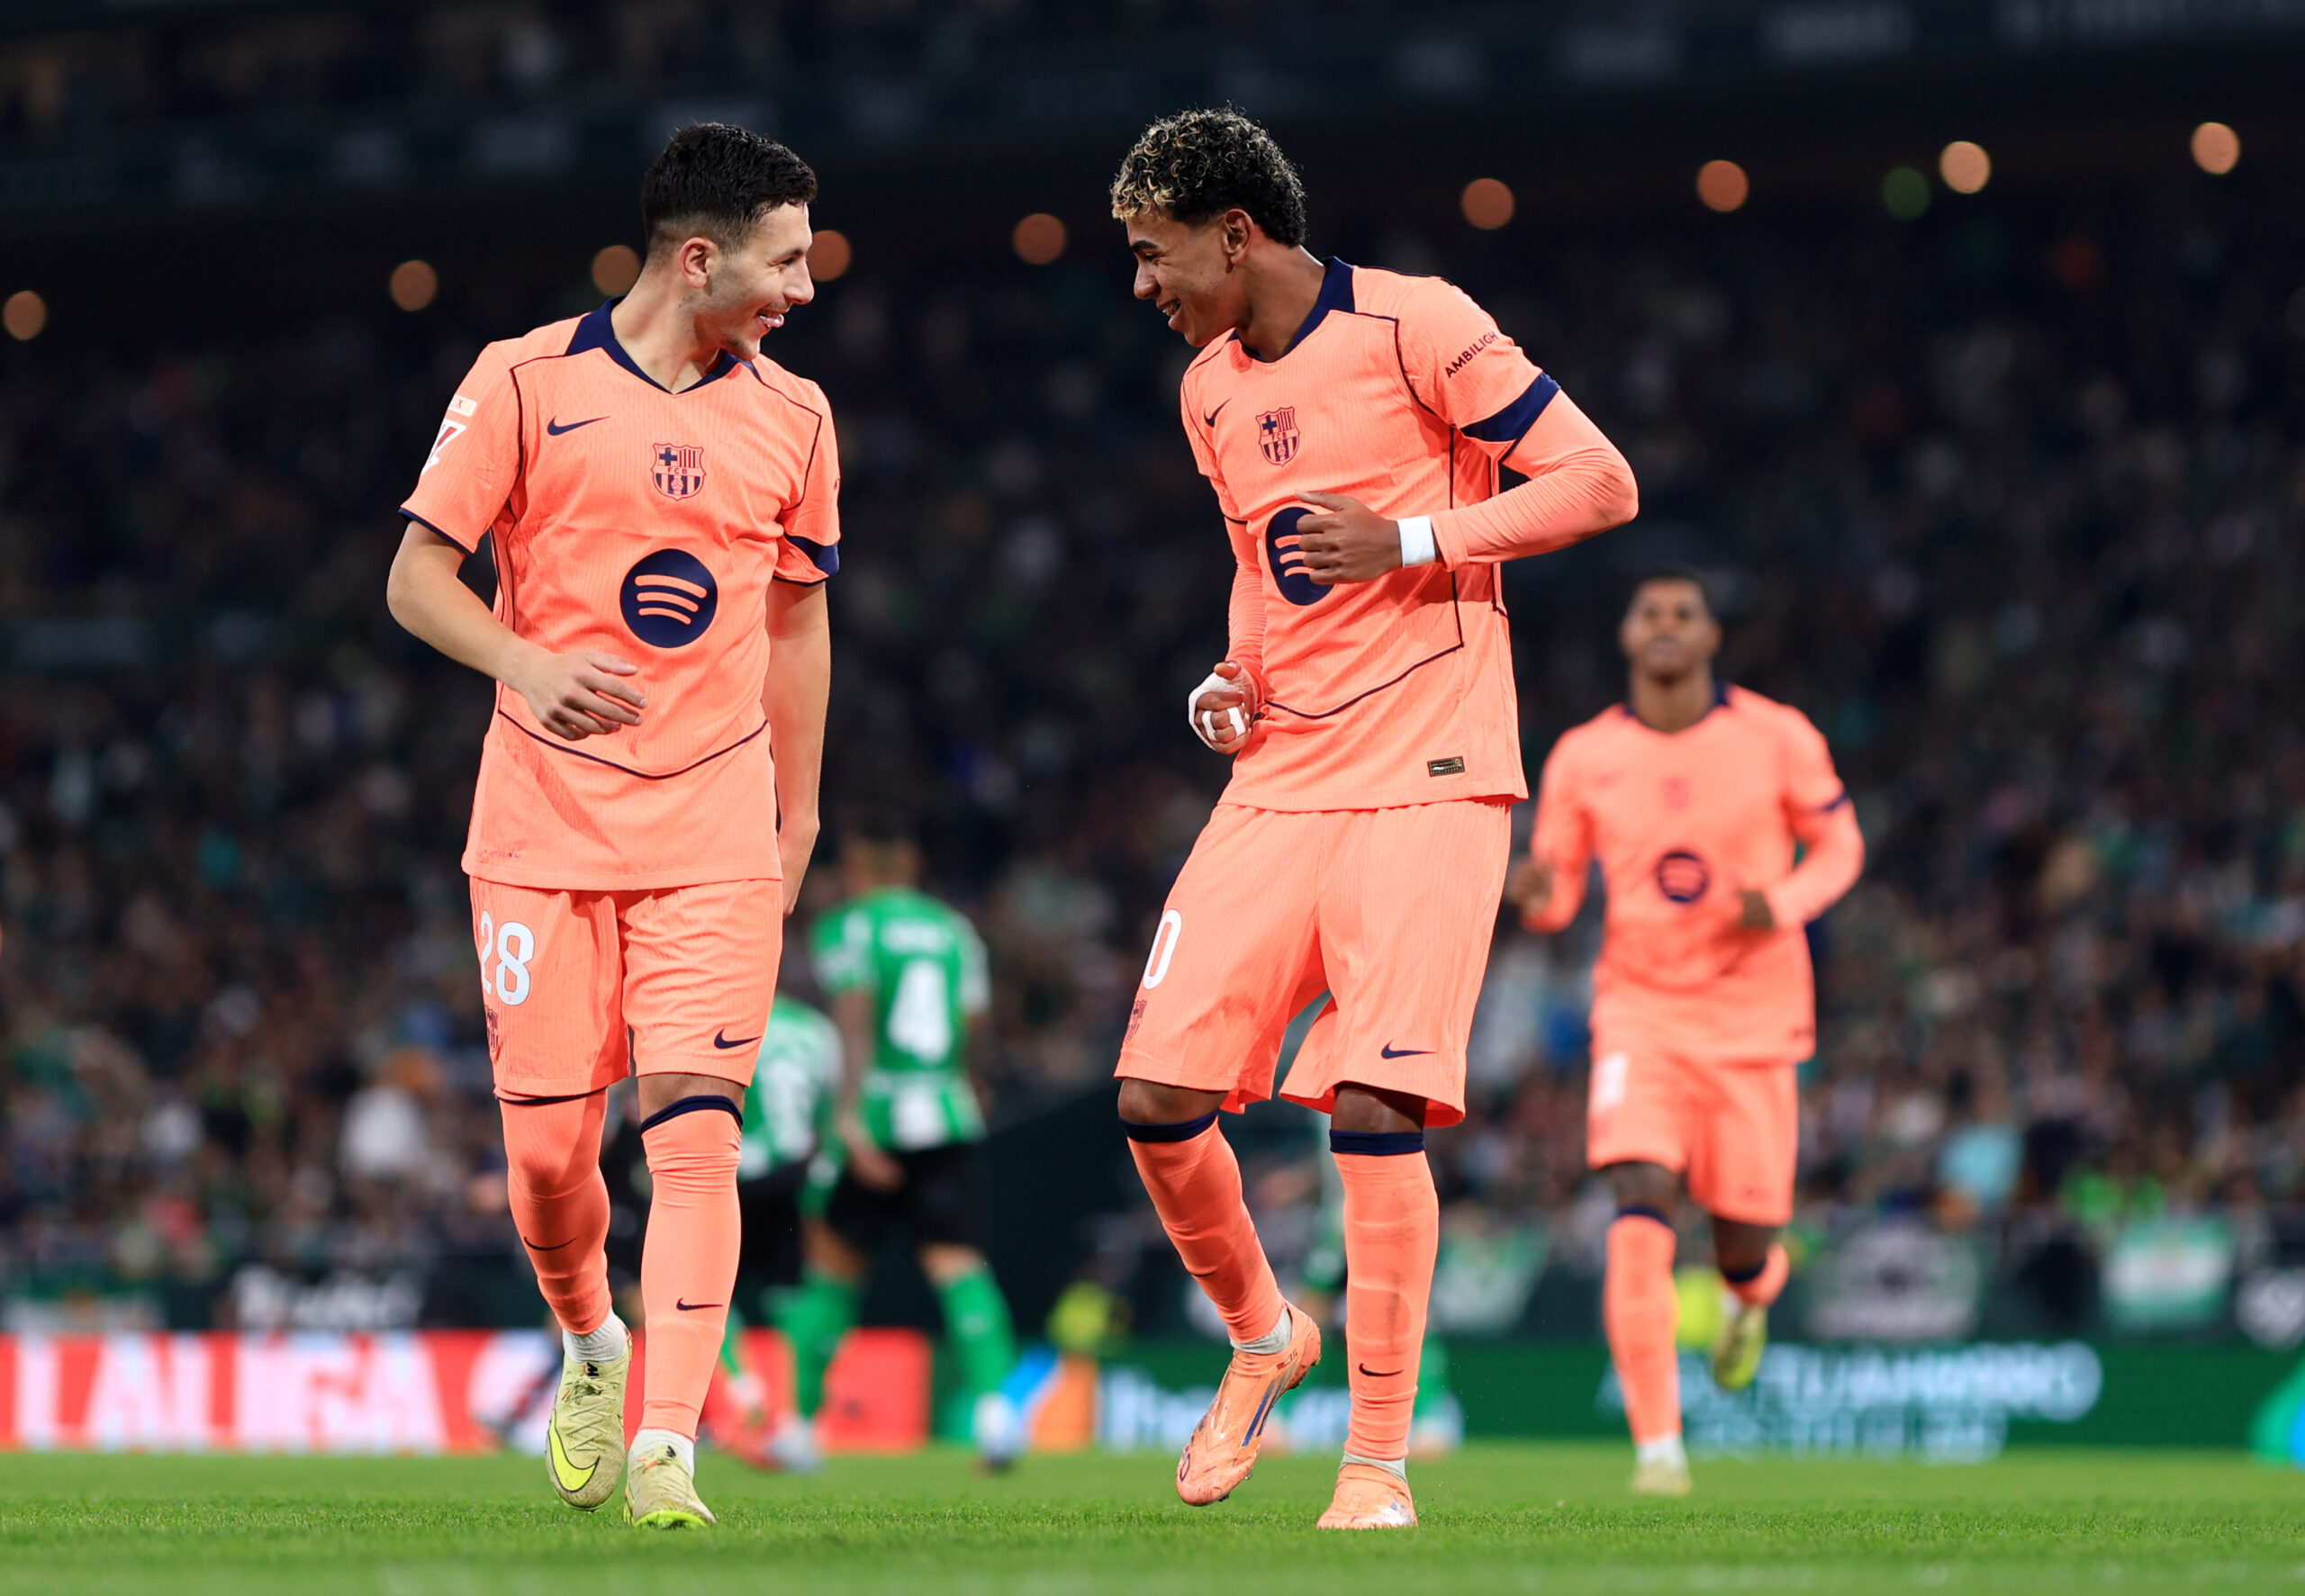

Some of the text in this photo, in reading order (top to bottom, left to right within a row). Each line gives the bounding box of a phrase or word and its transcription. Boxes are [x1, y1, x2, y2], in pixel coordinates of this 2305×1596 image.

[1445, 330, 1499, 378] AMBILIGH
[667, 466, 688, 475] FCB
[480, 910, 535, 1006] 28
